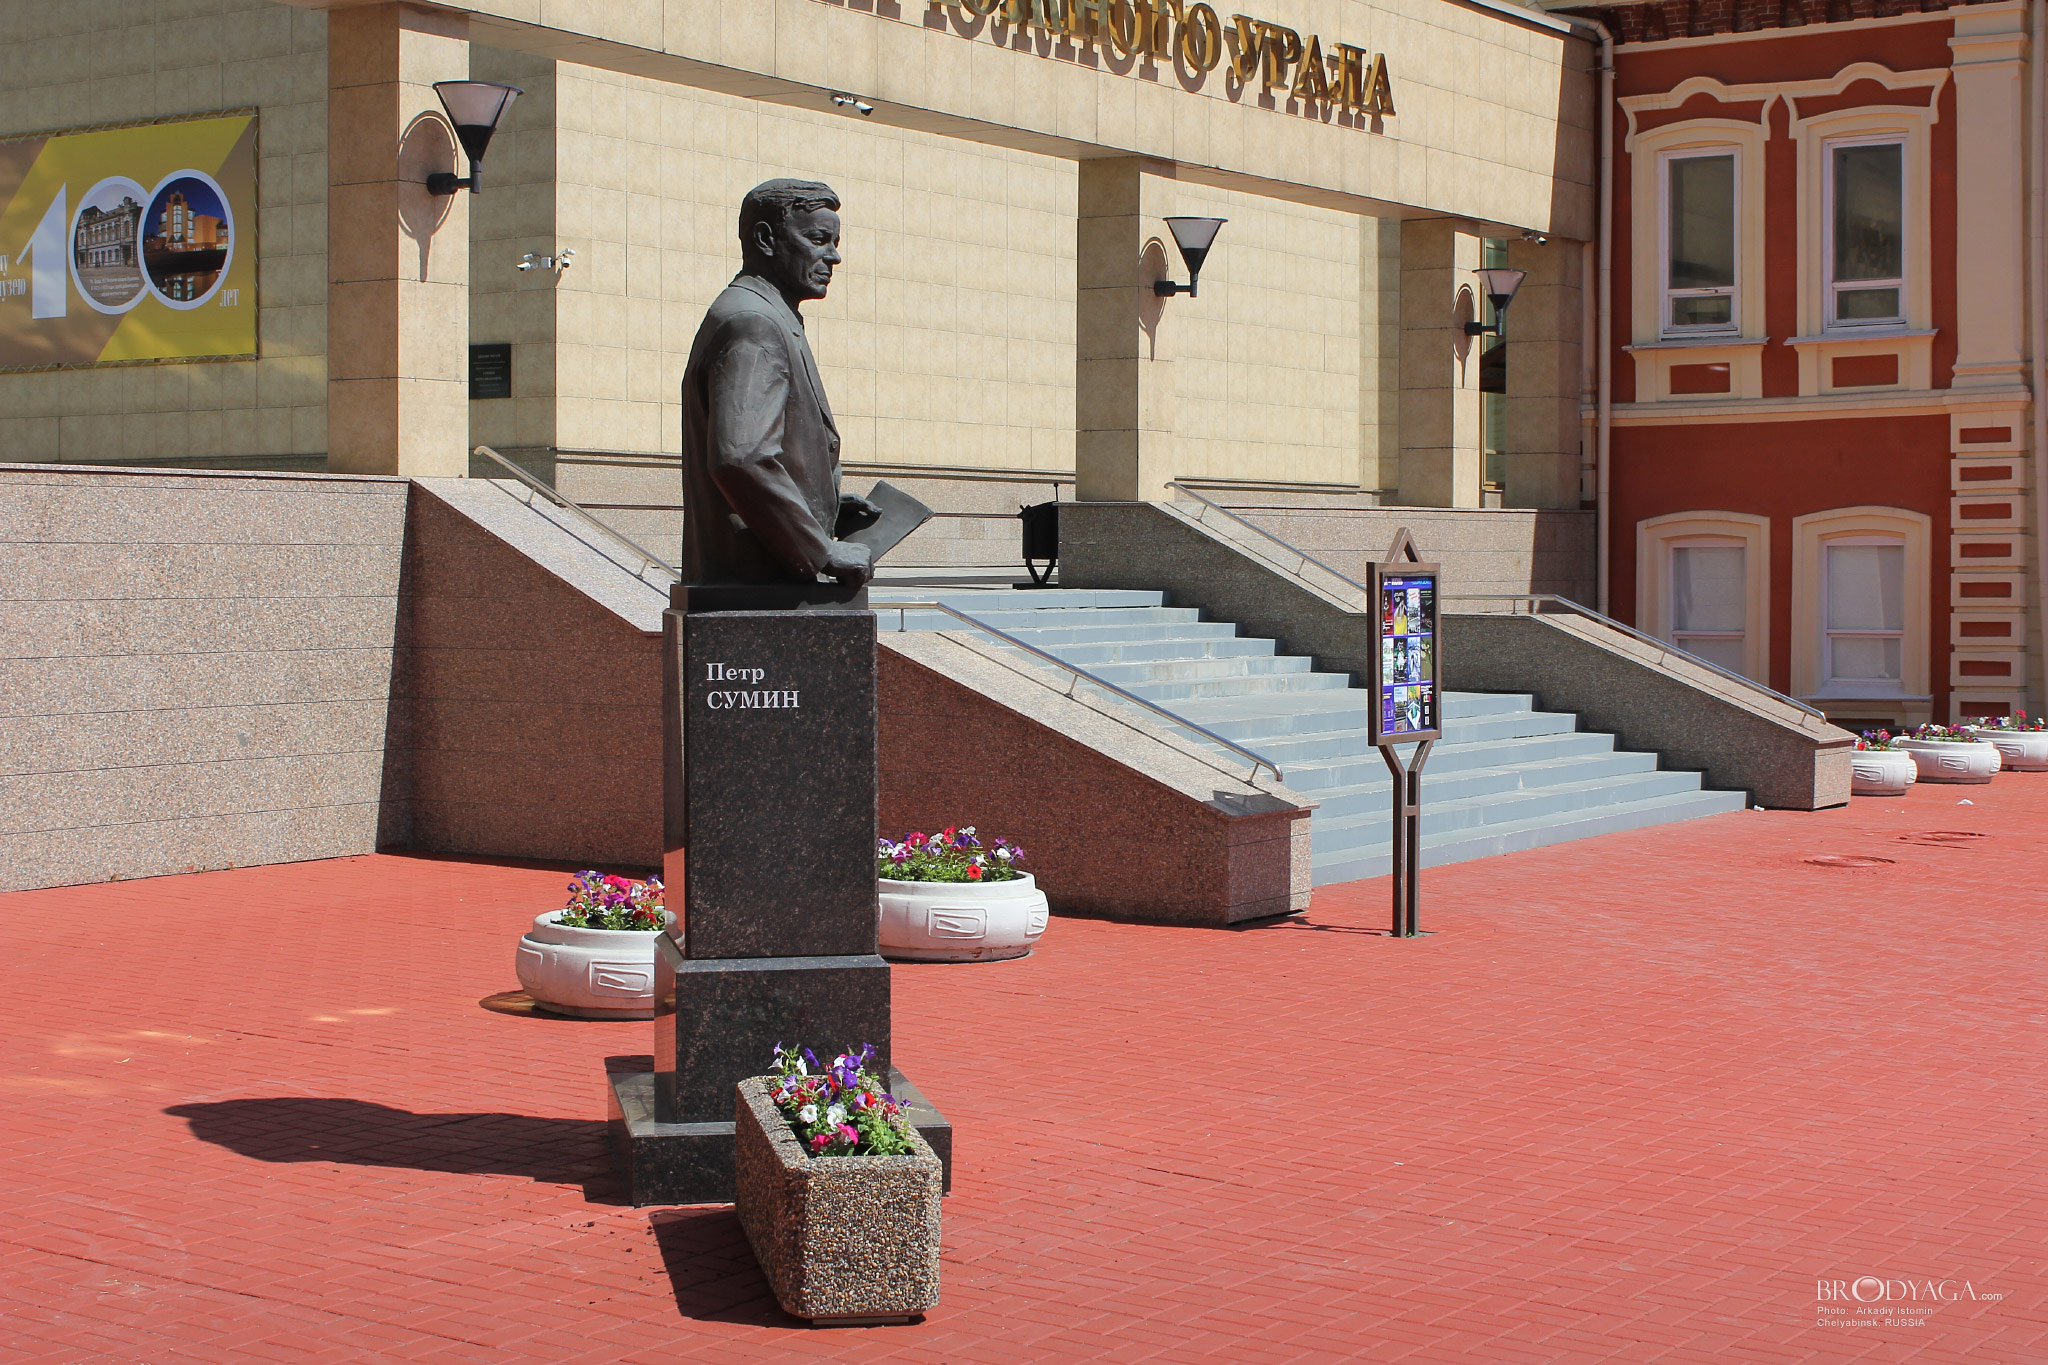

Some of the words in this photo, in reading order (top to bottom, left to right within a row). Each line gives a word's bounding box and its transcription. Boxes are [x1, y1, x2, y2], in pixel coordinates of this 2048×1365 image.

[929, 0, 1221, 72] НОГО
[1231, 13, 1397, 117] УРАЛА
[16, 169, 235, 319] 100
[219, 288, 240, 307] лет
[0, 279, 27, 303] узею
[706, 662, 765, 685] Петр
[706, 690, 800, 709] СУМИН
